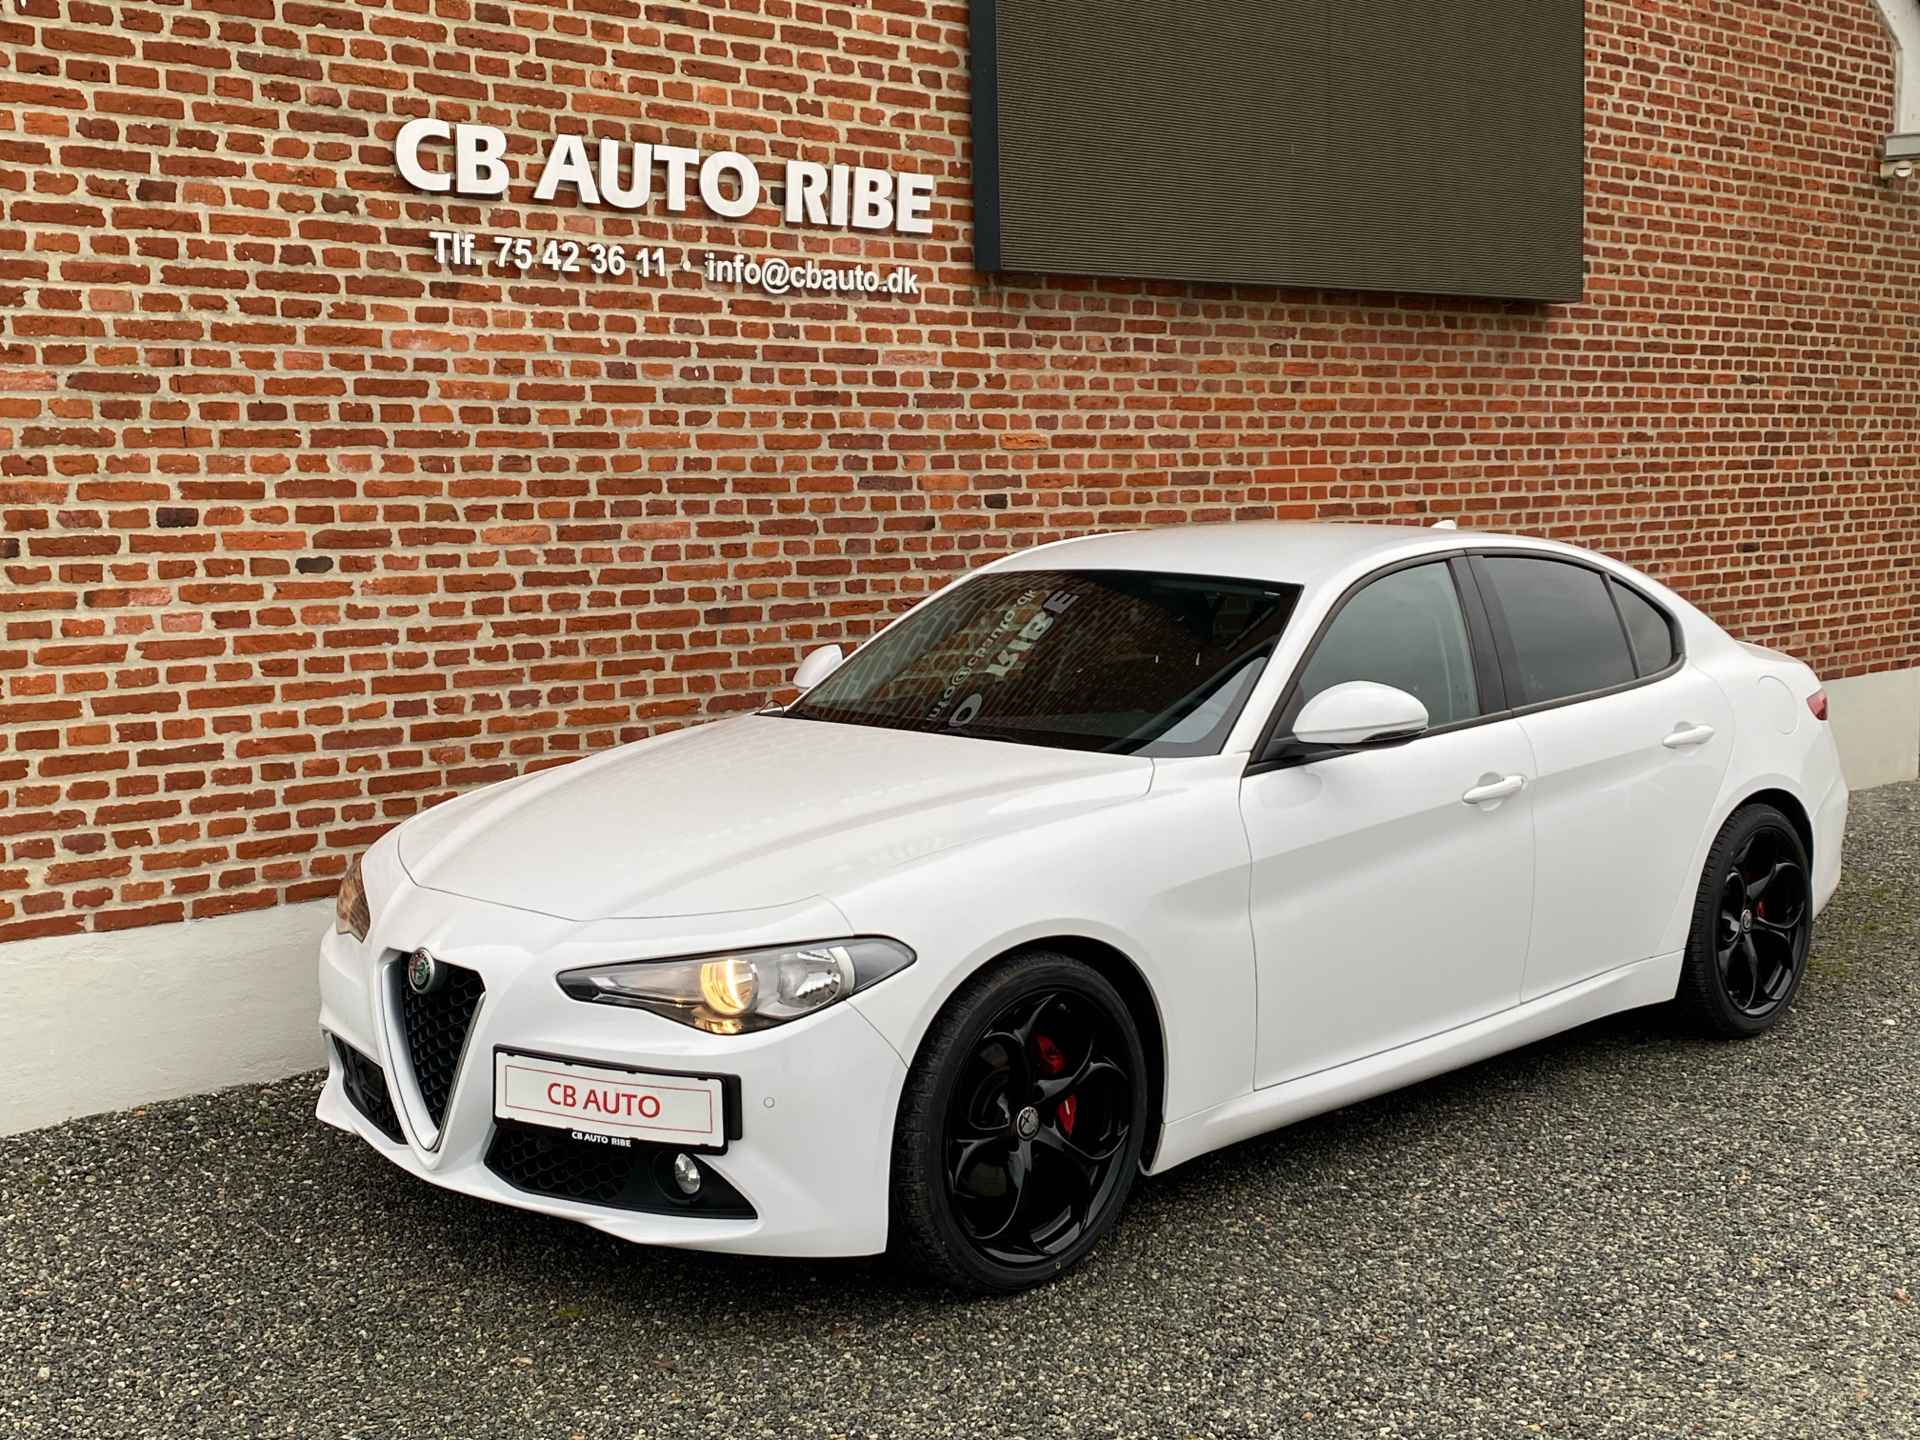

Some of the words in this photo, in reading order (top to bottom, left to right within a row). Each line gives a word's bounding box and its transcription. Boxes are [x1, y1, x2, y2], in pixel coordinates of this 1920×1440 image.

[395, 118, 510, 194] CB
[533, 134, 760, 218] AUTO
[785, 160, 934, 233] RIBE
[429, 230, 482, 266] Tlf.
[494, 236, 533, 270] 75
[542, 240, 580, 272] 42
[590, 243, 626, 276] 36
[635, 246, 667, 277] 11
[705, 252, 919, 295] info@cbauto.dk
[547, 1082, 577, 1108] CB
[583, 1089, 661, 1118] AUTO
[571, 1131, 583, 1140] CB
[584, 1133, 609, 1144] AUTO
[611, 1137, 631, 1147] RIBE
